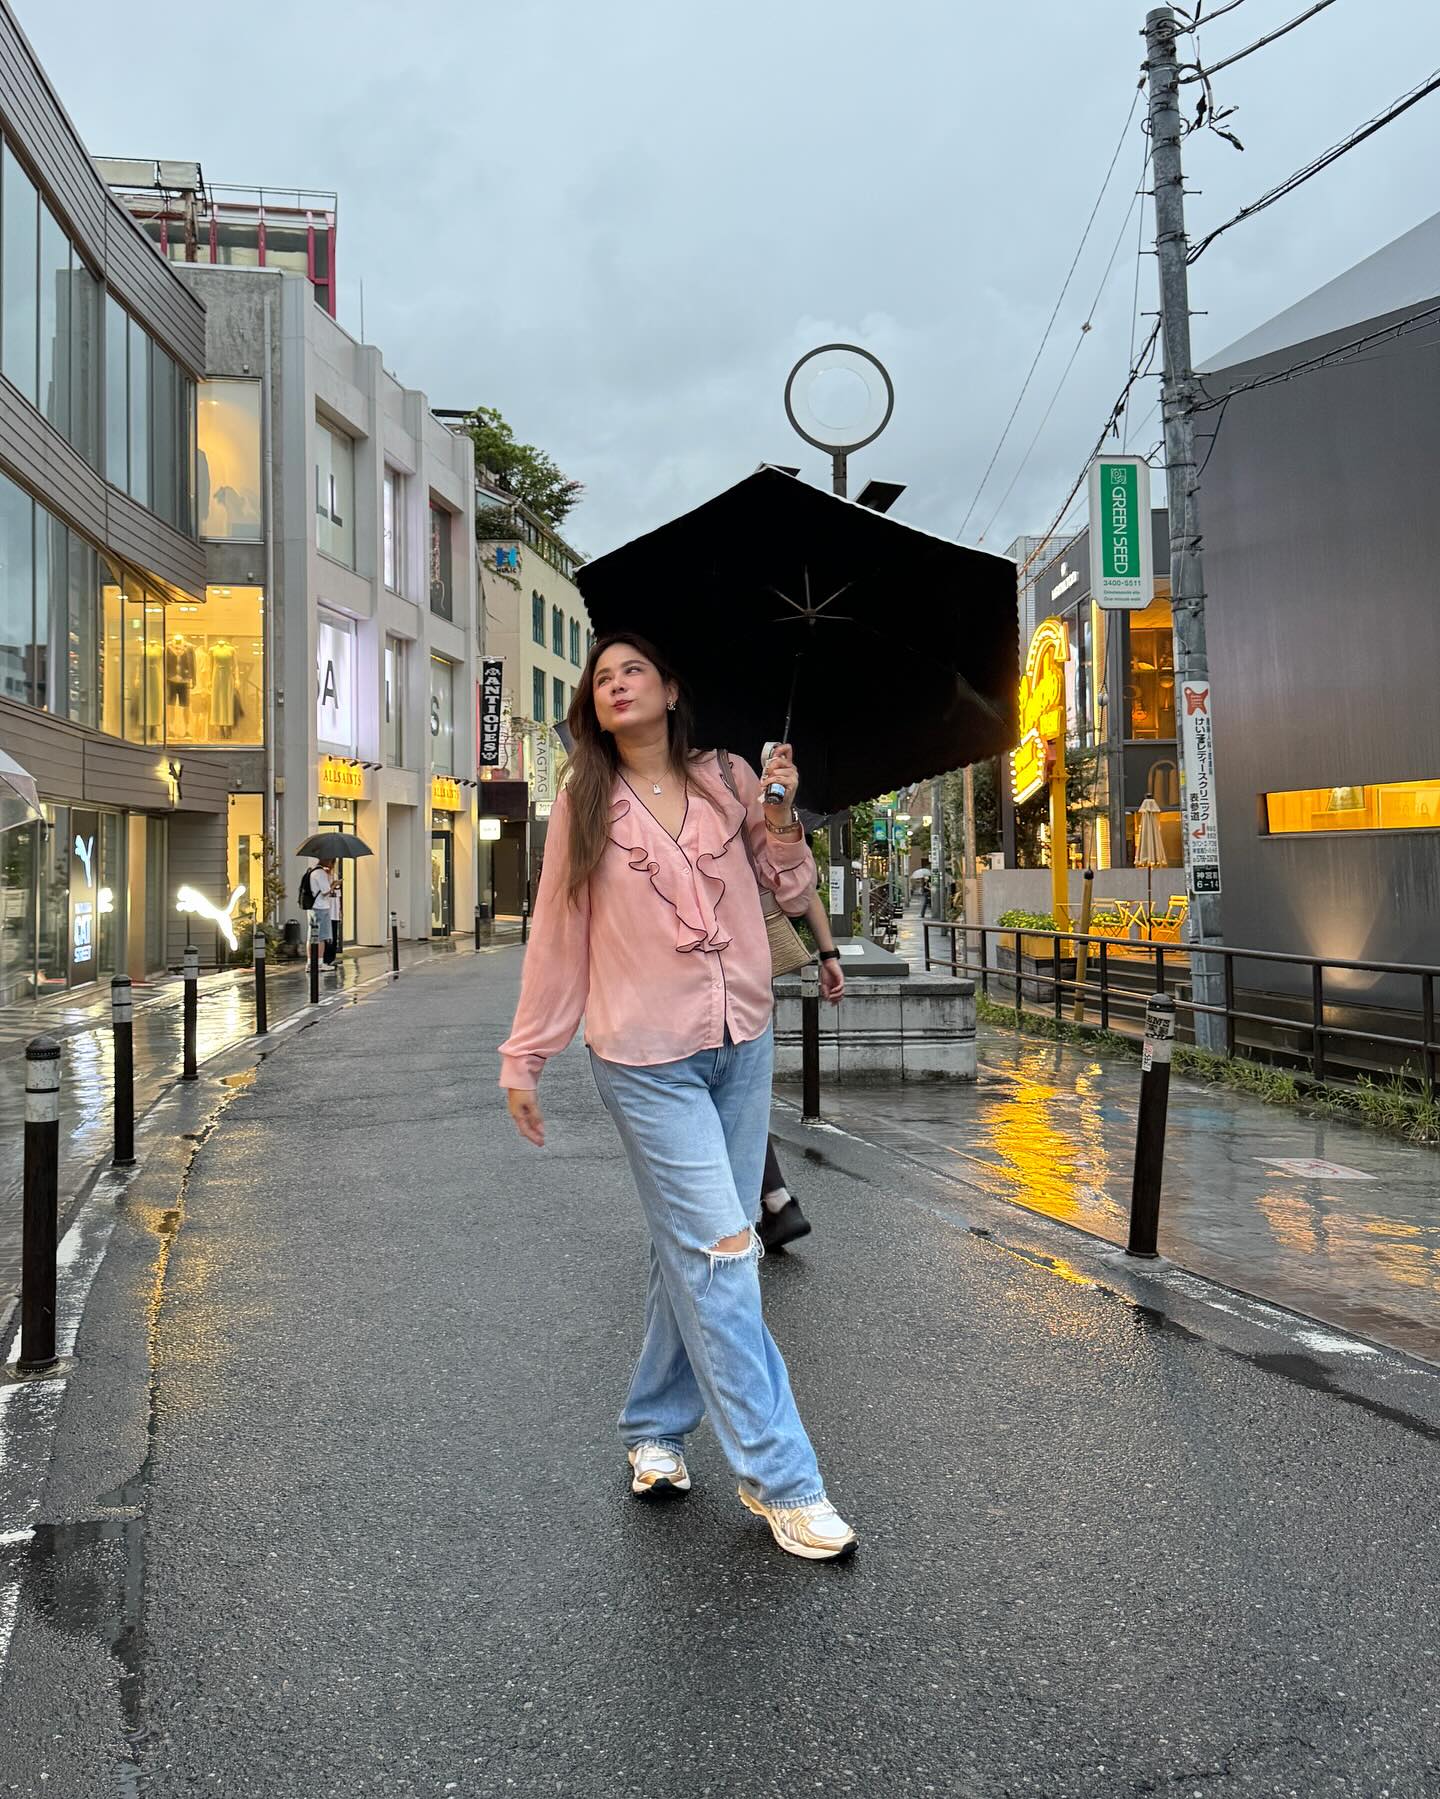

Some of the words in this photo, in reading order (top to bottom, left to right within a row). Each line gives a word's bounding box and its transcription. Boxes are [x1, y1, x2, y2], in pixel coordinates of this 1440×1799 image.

[1112, 486, 1127, 535] GREEN
[1113, 537, 1129, 574] SEED
[483, 676, 501, 752] ANTIQUES
[323, 769, 361, 786] ALLSAINTS
[536, 733, 548, 793] RAGTAG
[1190, 792, 1200, 821] 表参道
